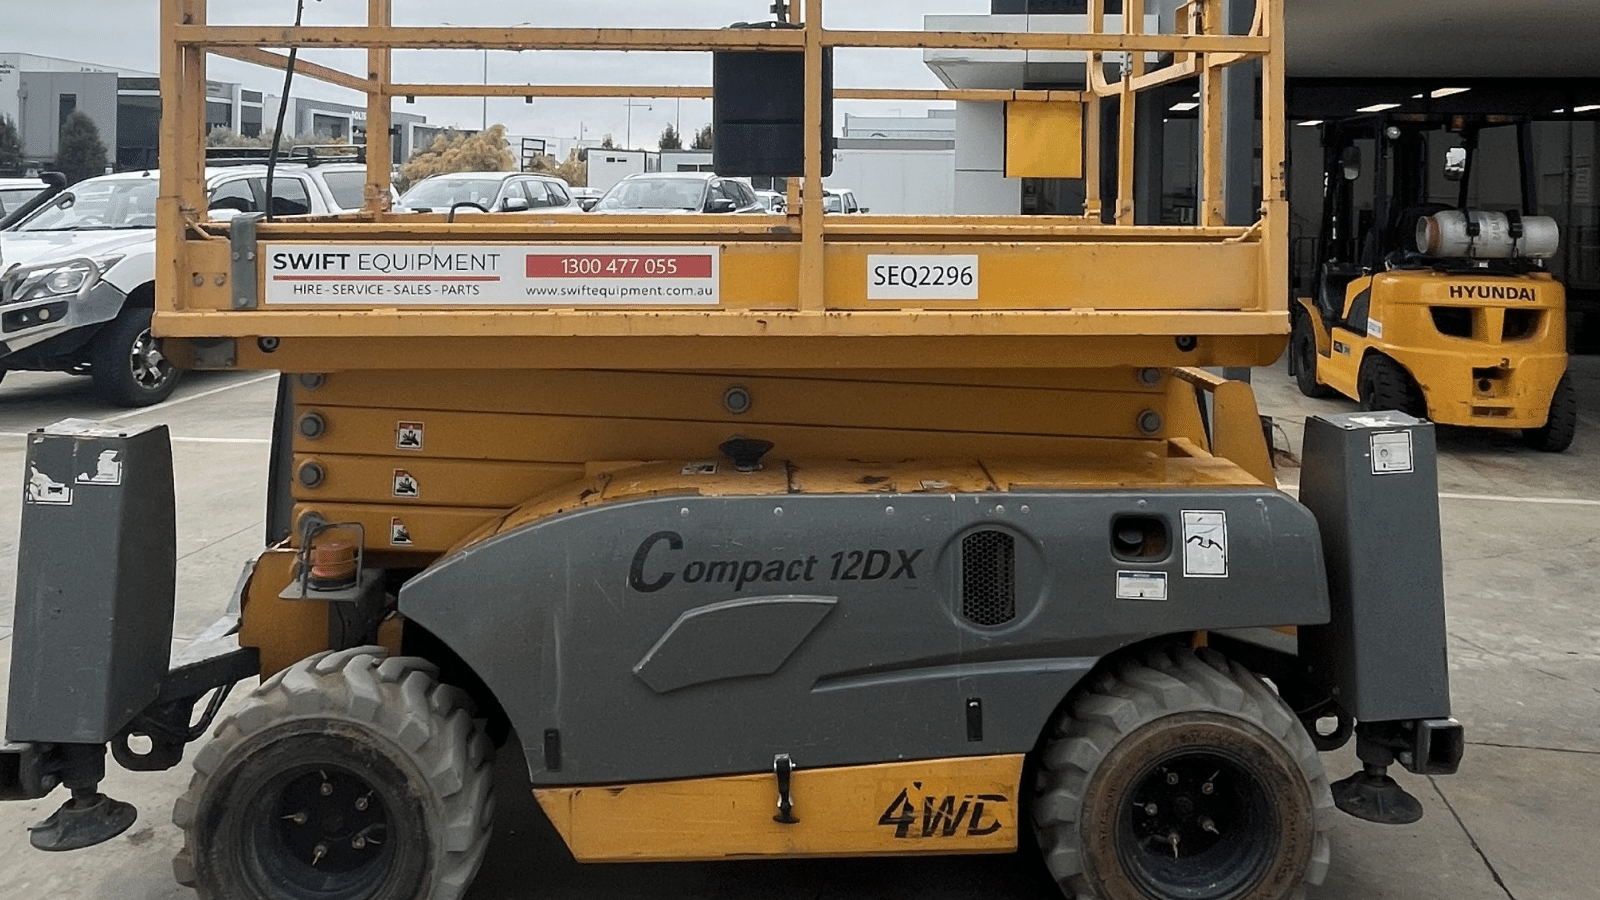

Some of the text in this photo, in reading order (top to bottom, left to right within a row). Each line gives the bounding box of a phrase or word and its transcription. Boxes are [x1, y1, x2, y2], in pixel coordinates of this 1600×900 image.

[273, 253, 500, 273] SWIFT EQUIPMENT
[561, 258, 678, 274] 1300 477 055
[874, 265, 973, 288] SEQ2296
[526, 285, 713, 298] www.swiftequipment.com.au
[1450, 285, 1536, 301] HYUNDAI
[629, 530, 925, 593] Compact 12DX
[878, 781, 1009, 838] 4WD
